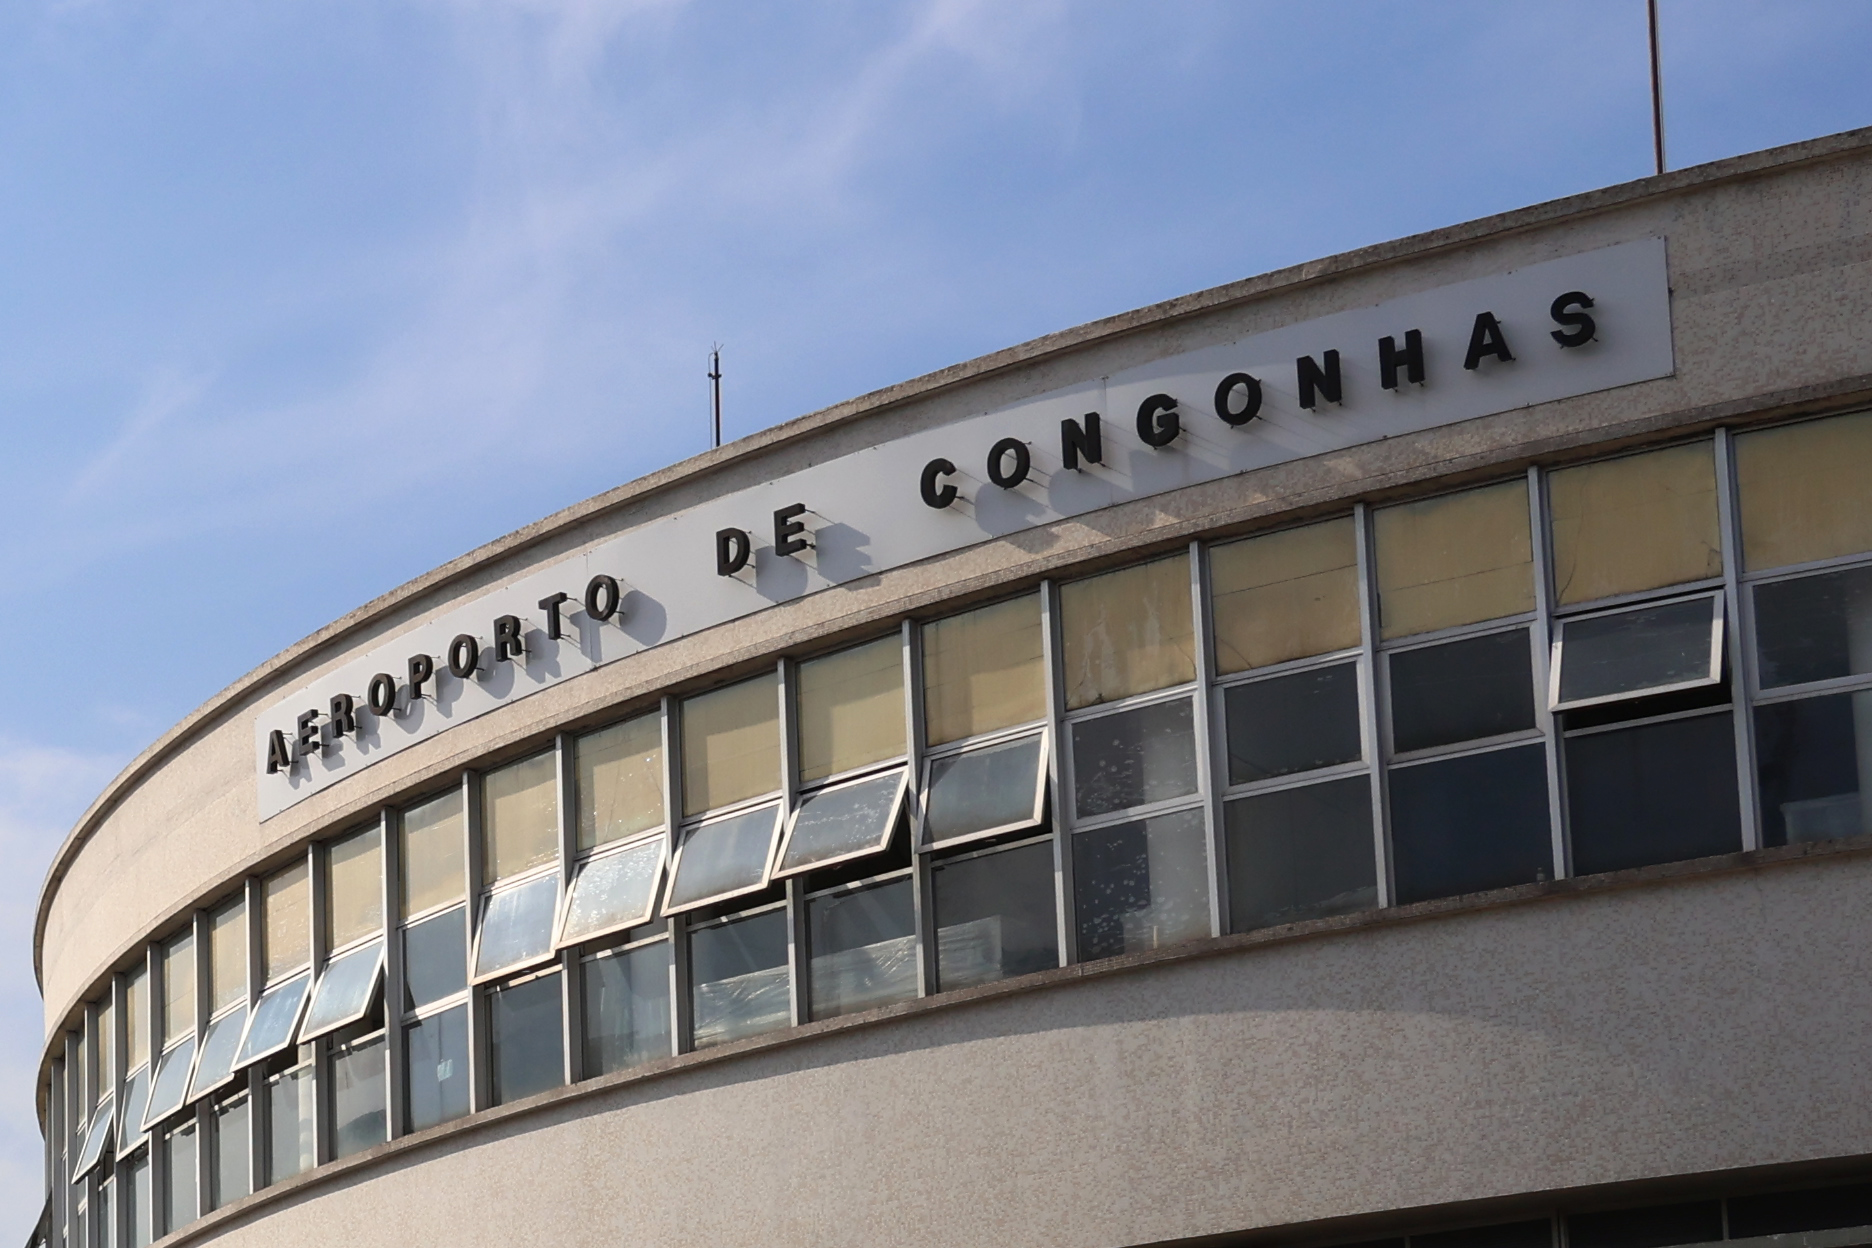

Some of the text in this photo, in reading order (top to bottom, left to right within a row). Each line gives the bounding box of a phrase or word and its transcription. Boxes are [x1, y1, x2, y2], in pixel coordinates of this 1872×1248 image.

[266, 291, 1596, 774] AEROPORTO DE CONGONHAS
